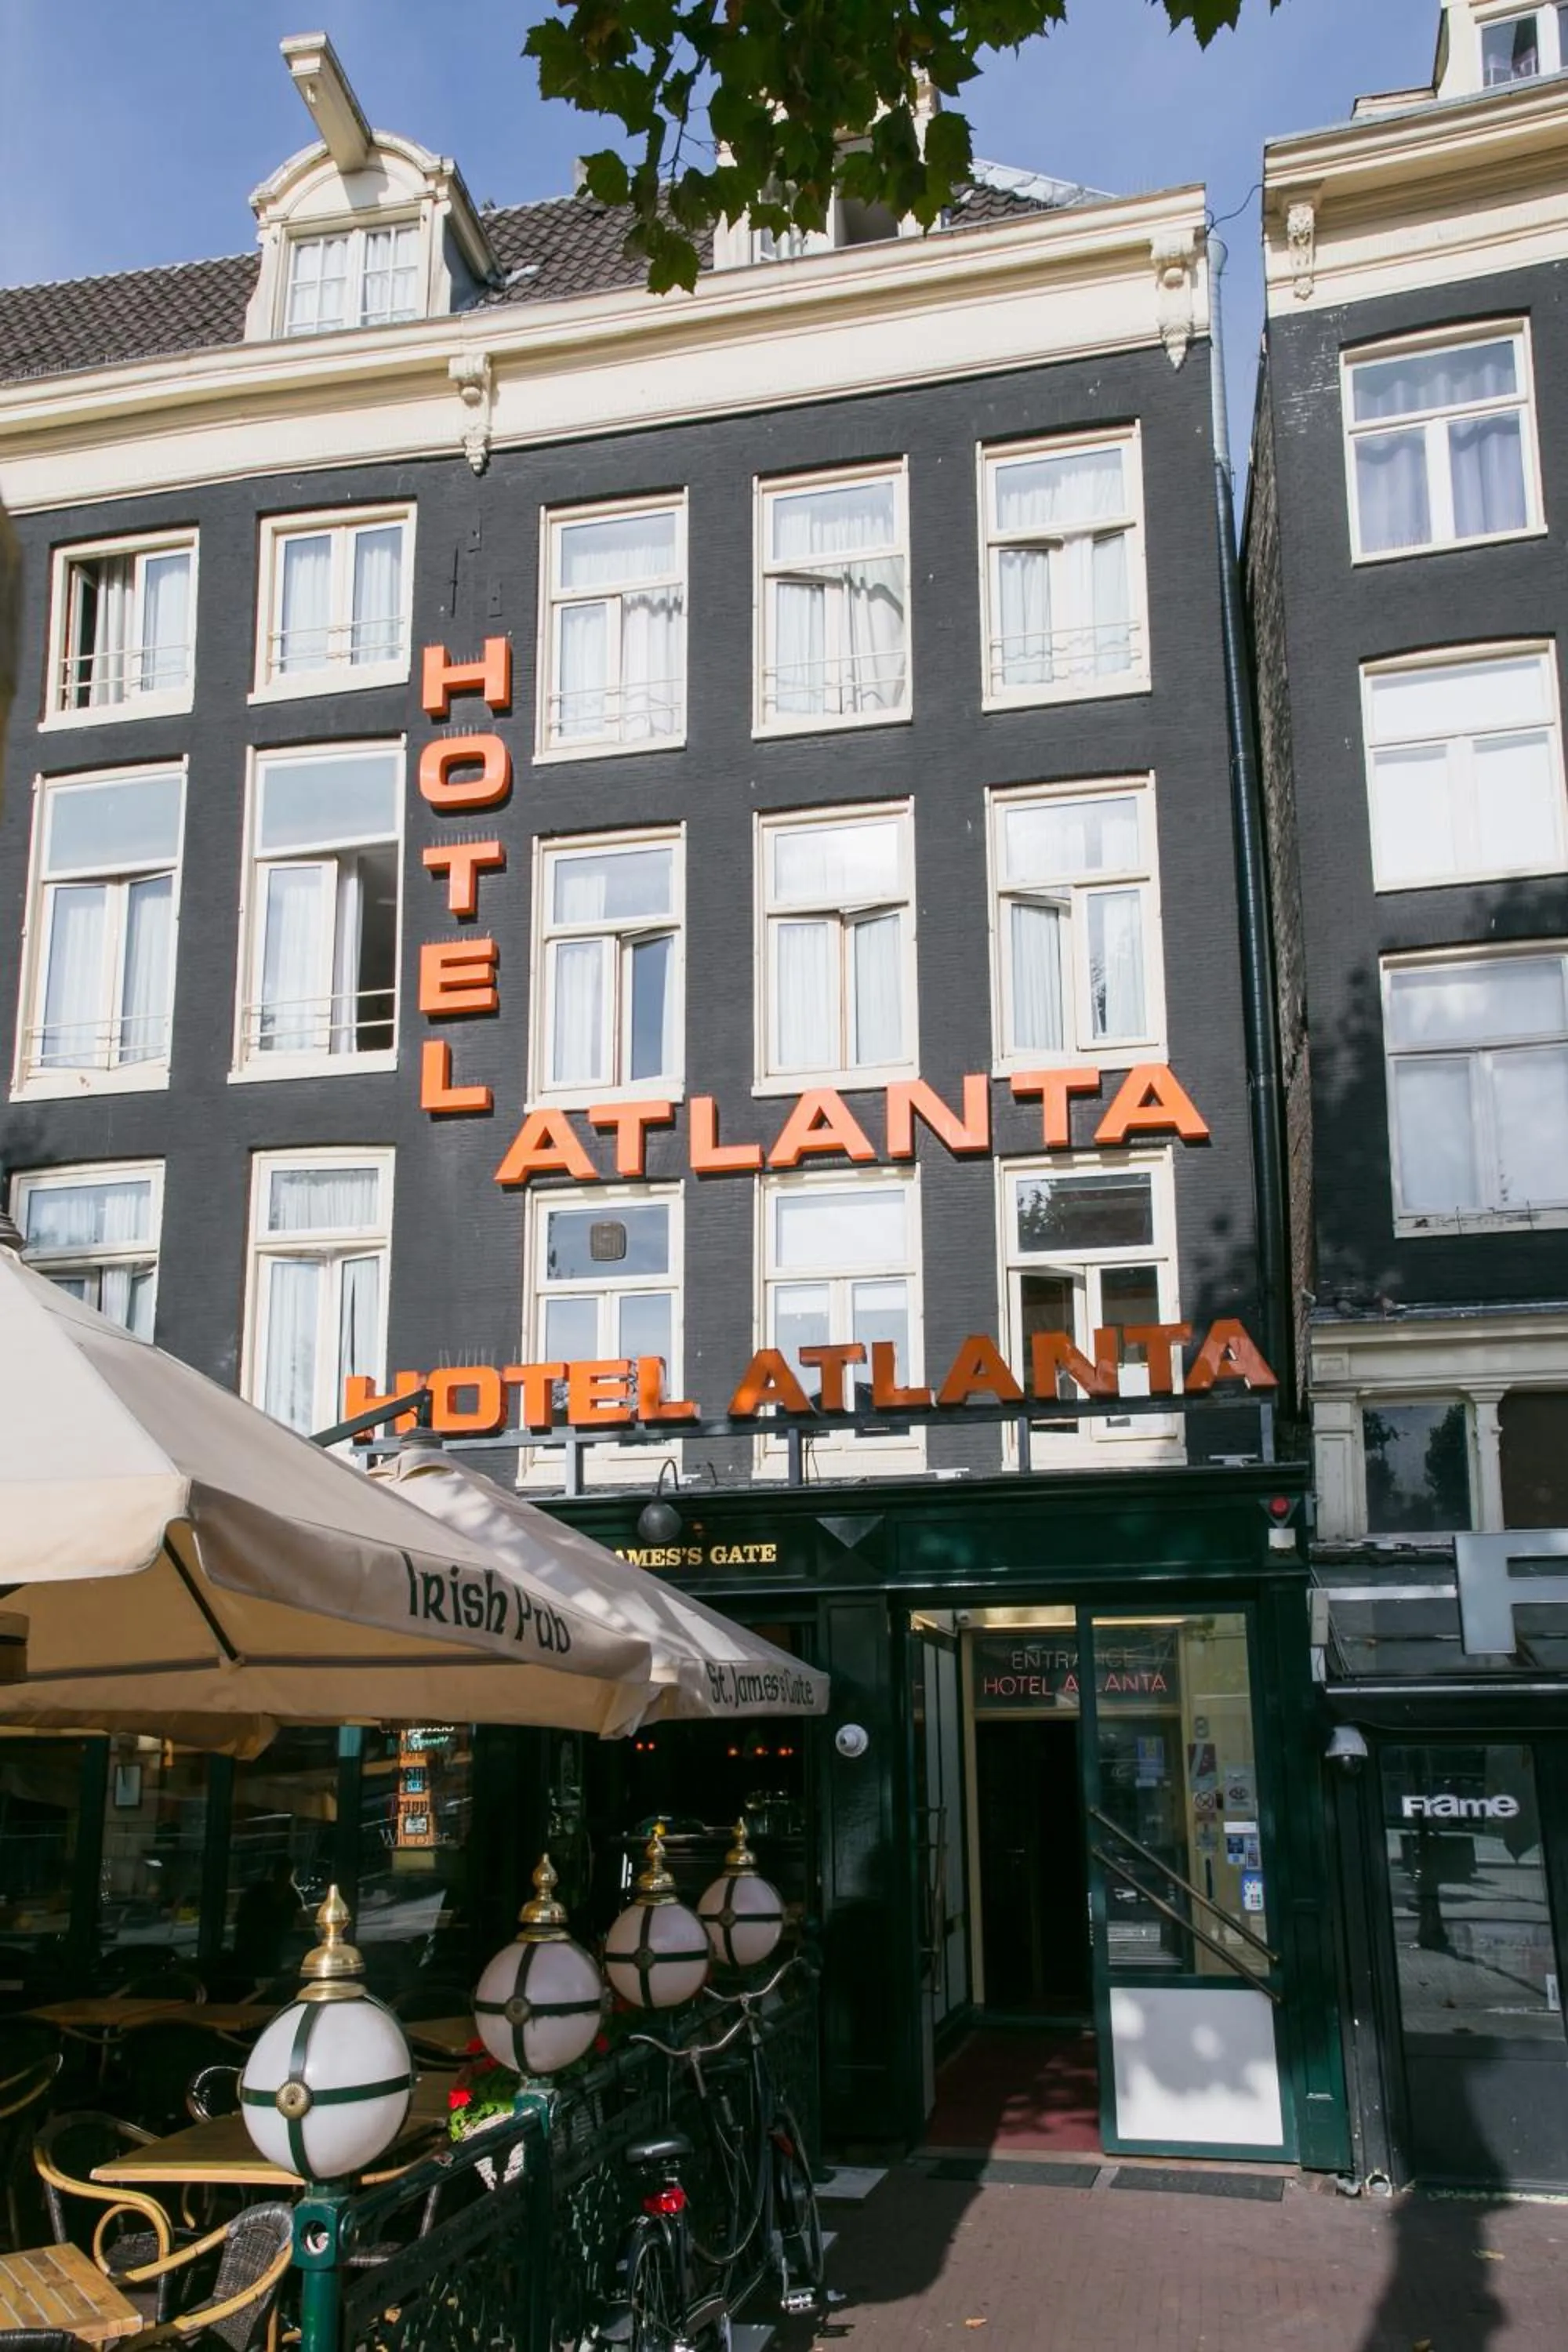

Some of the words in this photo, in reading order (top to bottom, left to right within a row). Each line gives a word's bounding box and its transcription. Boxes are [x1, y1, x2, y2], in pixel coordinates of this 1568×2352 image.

[419, 637, 511, 1112] HOTEL
[494, 1063, 1211, 1185] ATLANTA
[345, 1356, 702, 1439] HOTEL
[728, 1319, 1279, 1416] ATLANTA
[710, 1544, 777, 1565] GATE
[514, 1585, 572, 1654] Pub
[1011, 1648, 1137, 1670] ENTRCE
[984, 1675, 1054, 1697] HOTEL
[1063, 1671, 1167, 1695] AANTA
[1402, 1795, 1519, 1817] Frame
